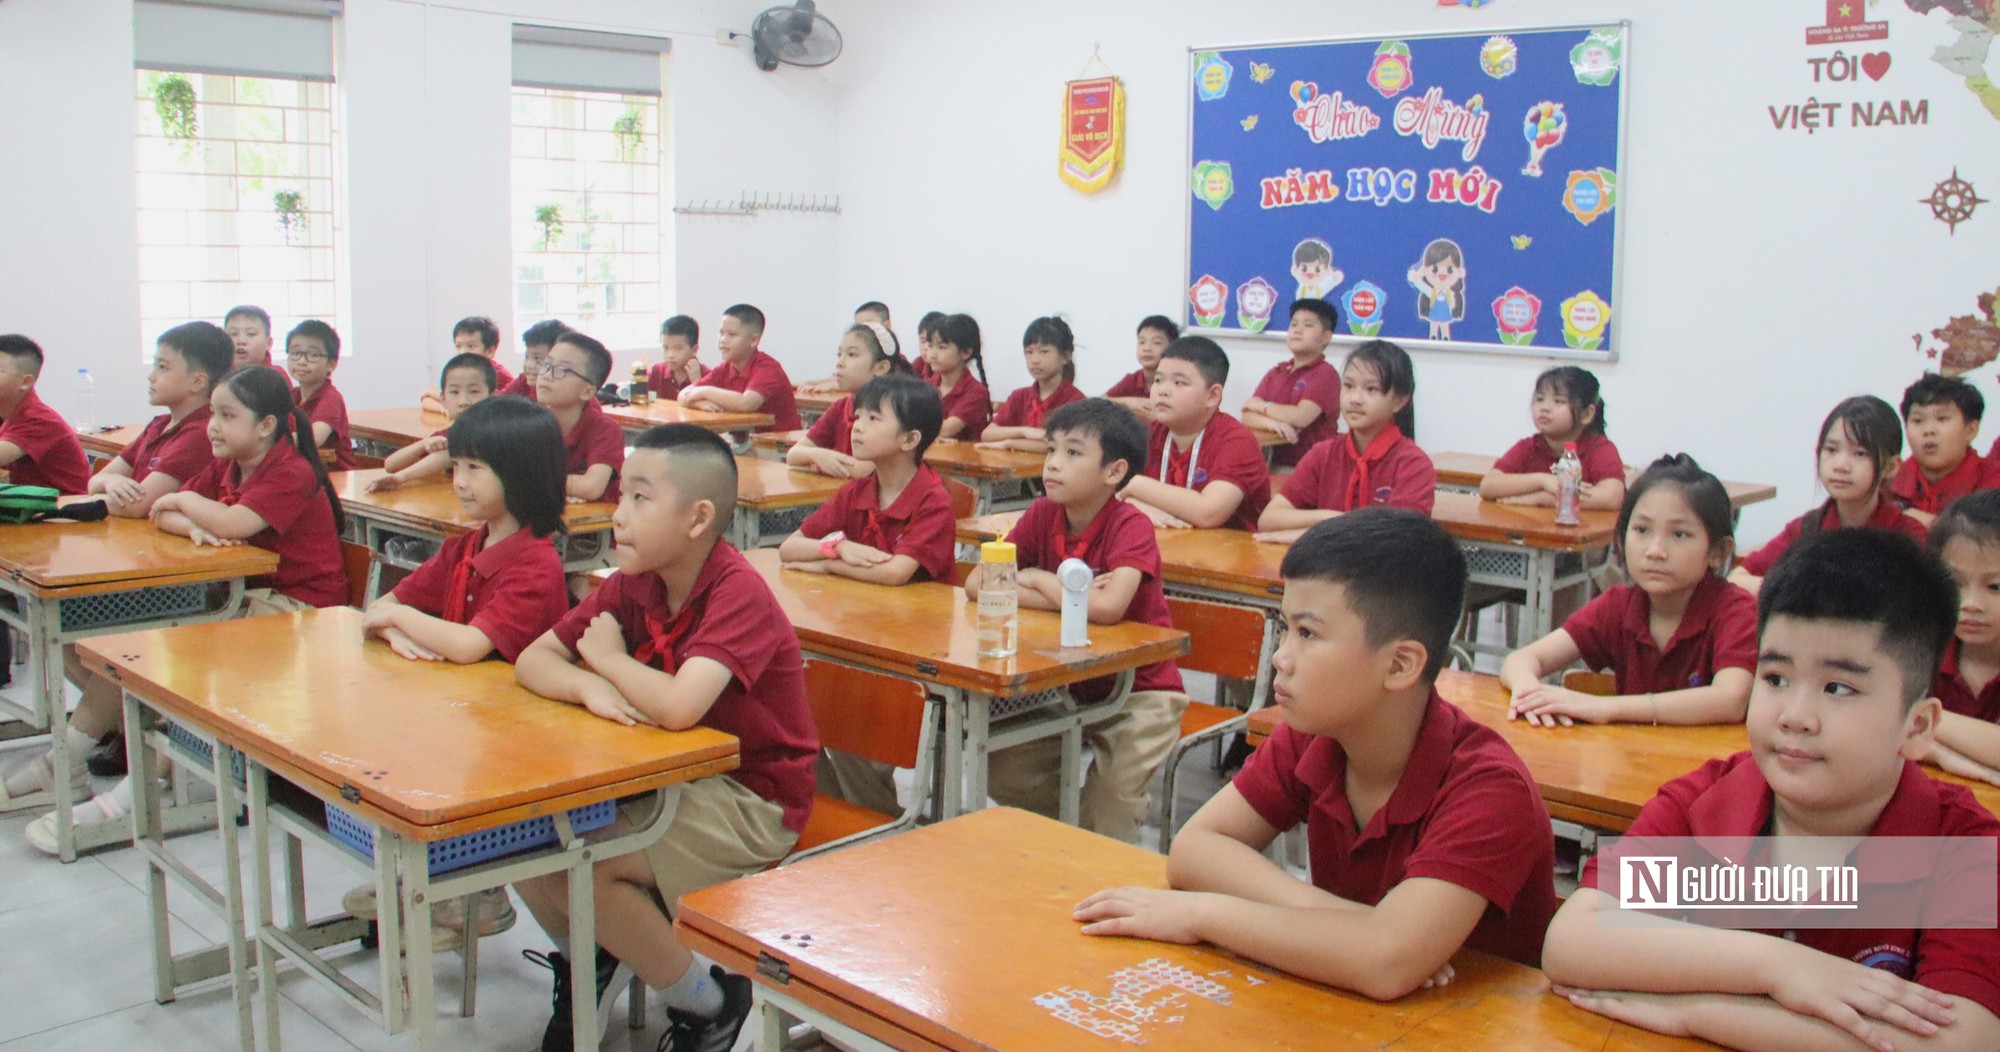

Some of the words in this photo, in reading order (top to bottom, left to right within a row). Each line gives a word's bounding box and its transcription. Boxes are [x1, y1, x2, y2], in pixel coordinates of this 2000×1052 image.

[1807, 50, 1857, 82] TÔI
[1300, 92, 1374, 142] Chào
[1395, 87, 1487, 160] Mừng
[1768, 97, 1842, 134] VIỆT
[1851, 99, 1929, 128] NAM
[1262, 169, 1334, 208] NĂM
[1348, 170, 1415, 204] HỌC
[1428, 168, 1500, 211] MỚI
